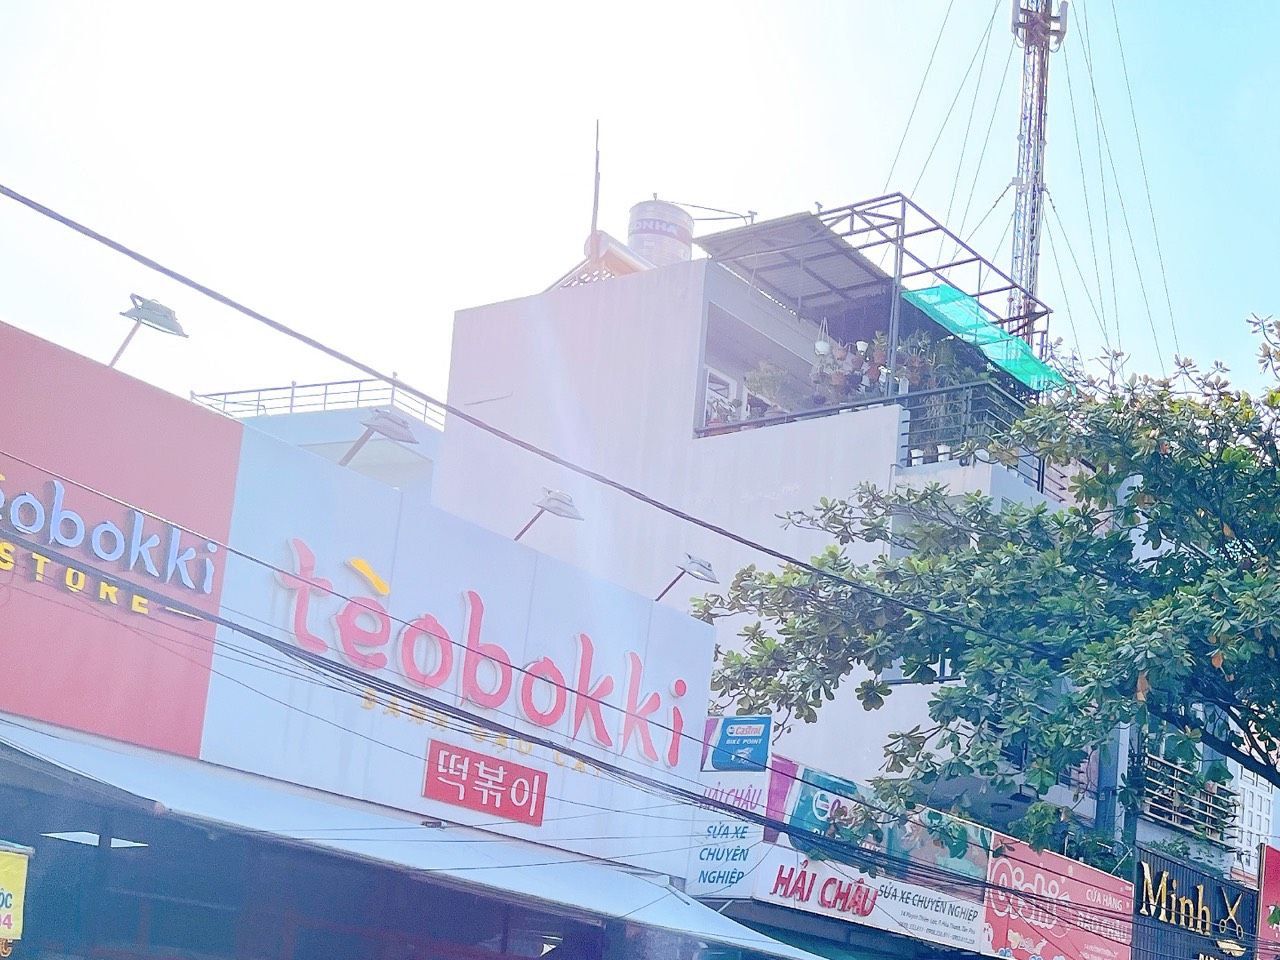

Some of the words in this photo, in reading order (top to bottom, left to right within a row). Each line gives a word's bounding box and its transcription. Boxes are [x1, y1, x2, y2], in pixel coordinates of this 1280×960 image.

[735, 725, 763, 736] Castrol
[437, 750, 540, 816] 떡볶이
[733, 826, 749, 839] XE
[770, 859, 817, 902] HẢI
[818, 877, 879, 917] CHÂU
[898, 890, 913, 906] XE
[1140, 861, 1211, 936] Minh
